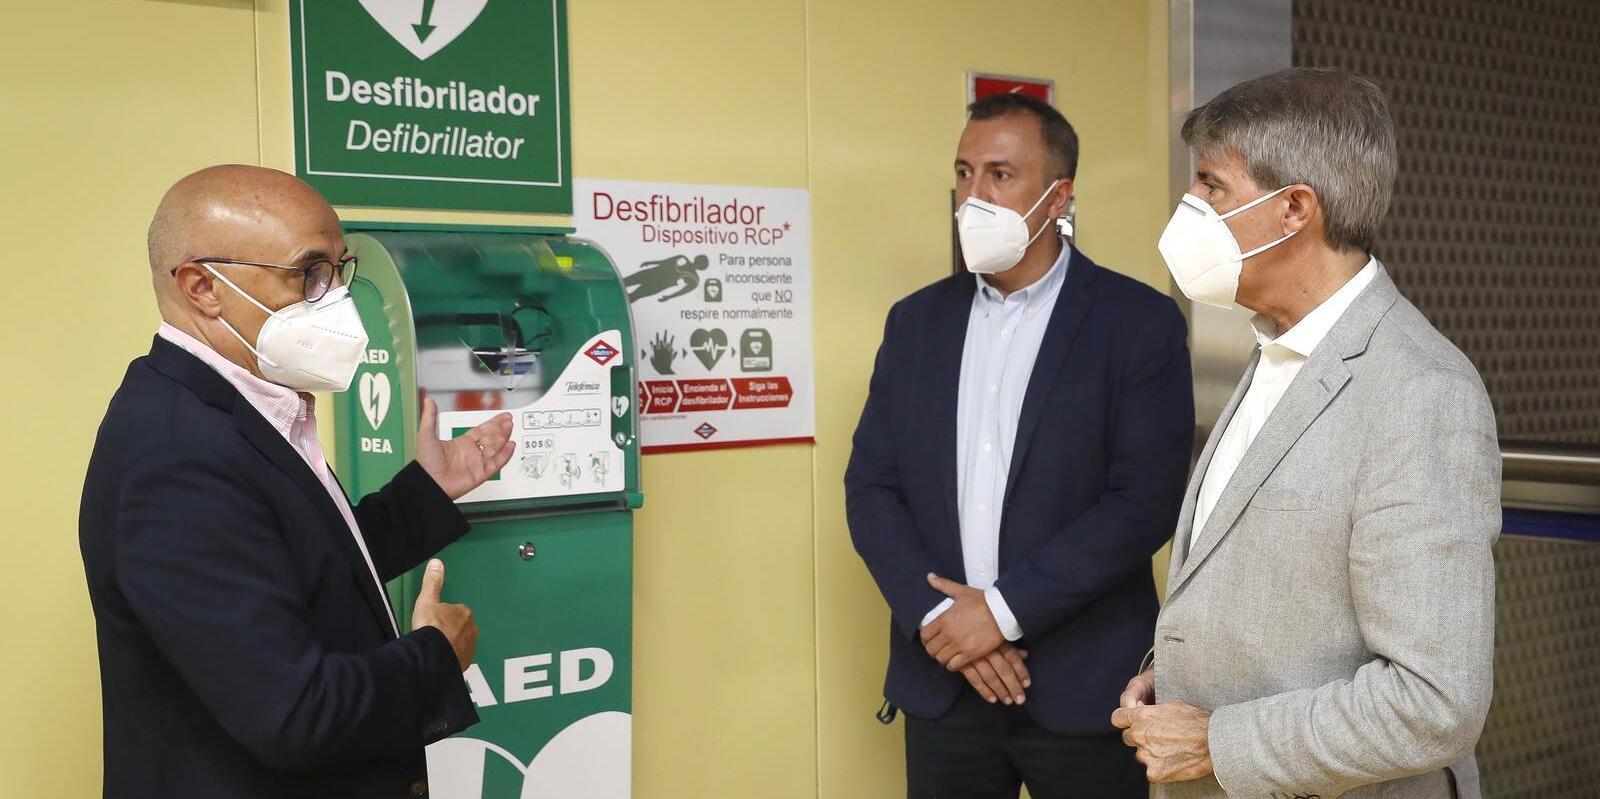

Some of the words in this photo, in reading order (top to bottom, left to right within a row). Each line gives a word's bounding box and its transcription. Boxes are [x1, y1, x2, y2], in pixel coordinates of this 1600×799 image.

[325, 70, 540, 117] Desfibrilador
[346, 119, 525, 160] Defibrillator
[593, 192, 766, 226] Desfibrilador
[642, 225, 739, 248] Dispositivo
[719, 253, 746, 266] Para
[749, 255, 792, 268] persona
[725, 273, 793, 285] inconsciente
[751, 291, 772, 304] que
[775, 289, 793, 303] NO
[680, 309, 720, 322] respire
[722, 308, 793, 320] normalmente
[360, 349, 390, 364] AED
[651, 385, 675, 394] Inicio
[748, 381, 766, 392] Siga
[654, 397, 673, 407] RCP
[361, 437, 393, 454] DEA
[525, 440, 544, 449] SOS
[463, 647, 614, 708] AED
